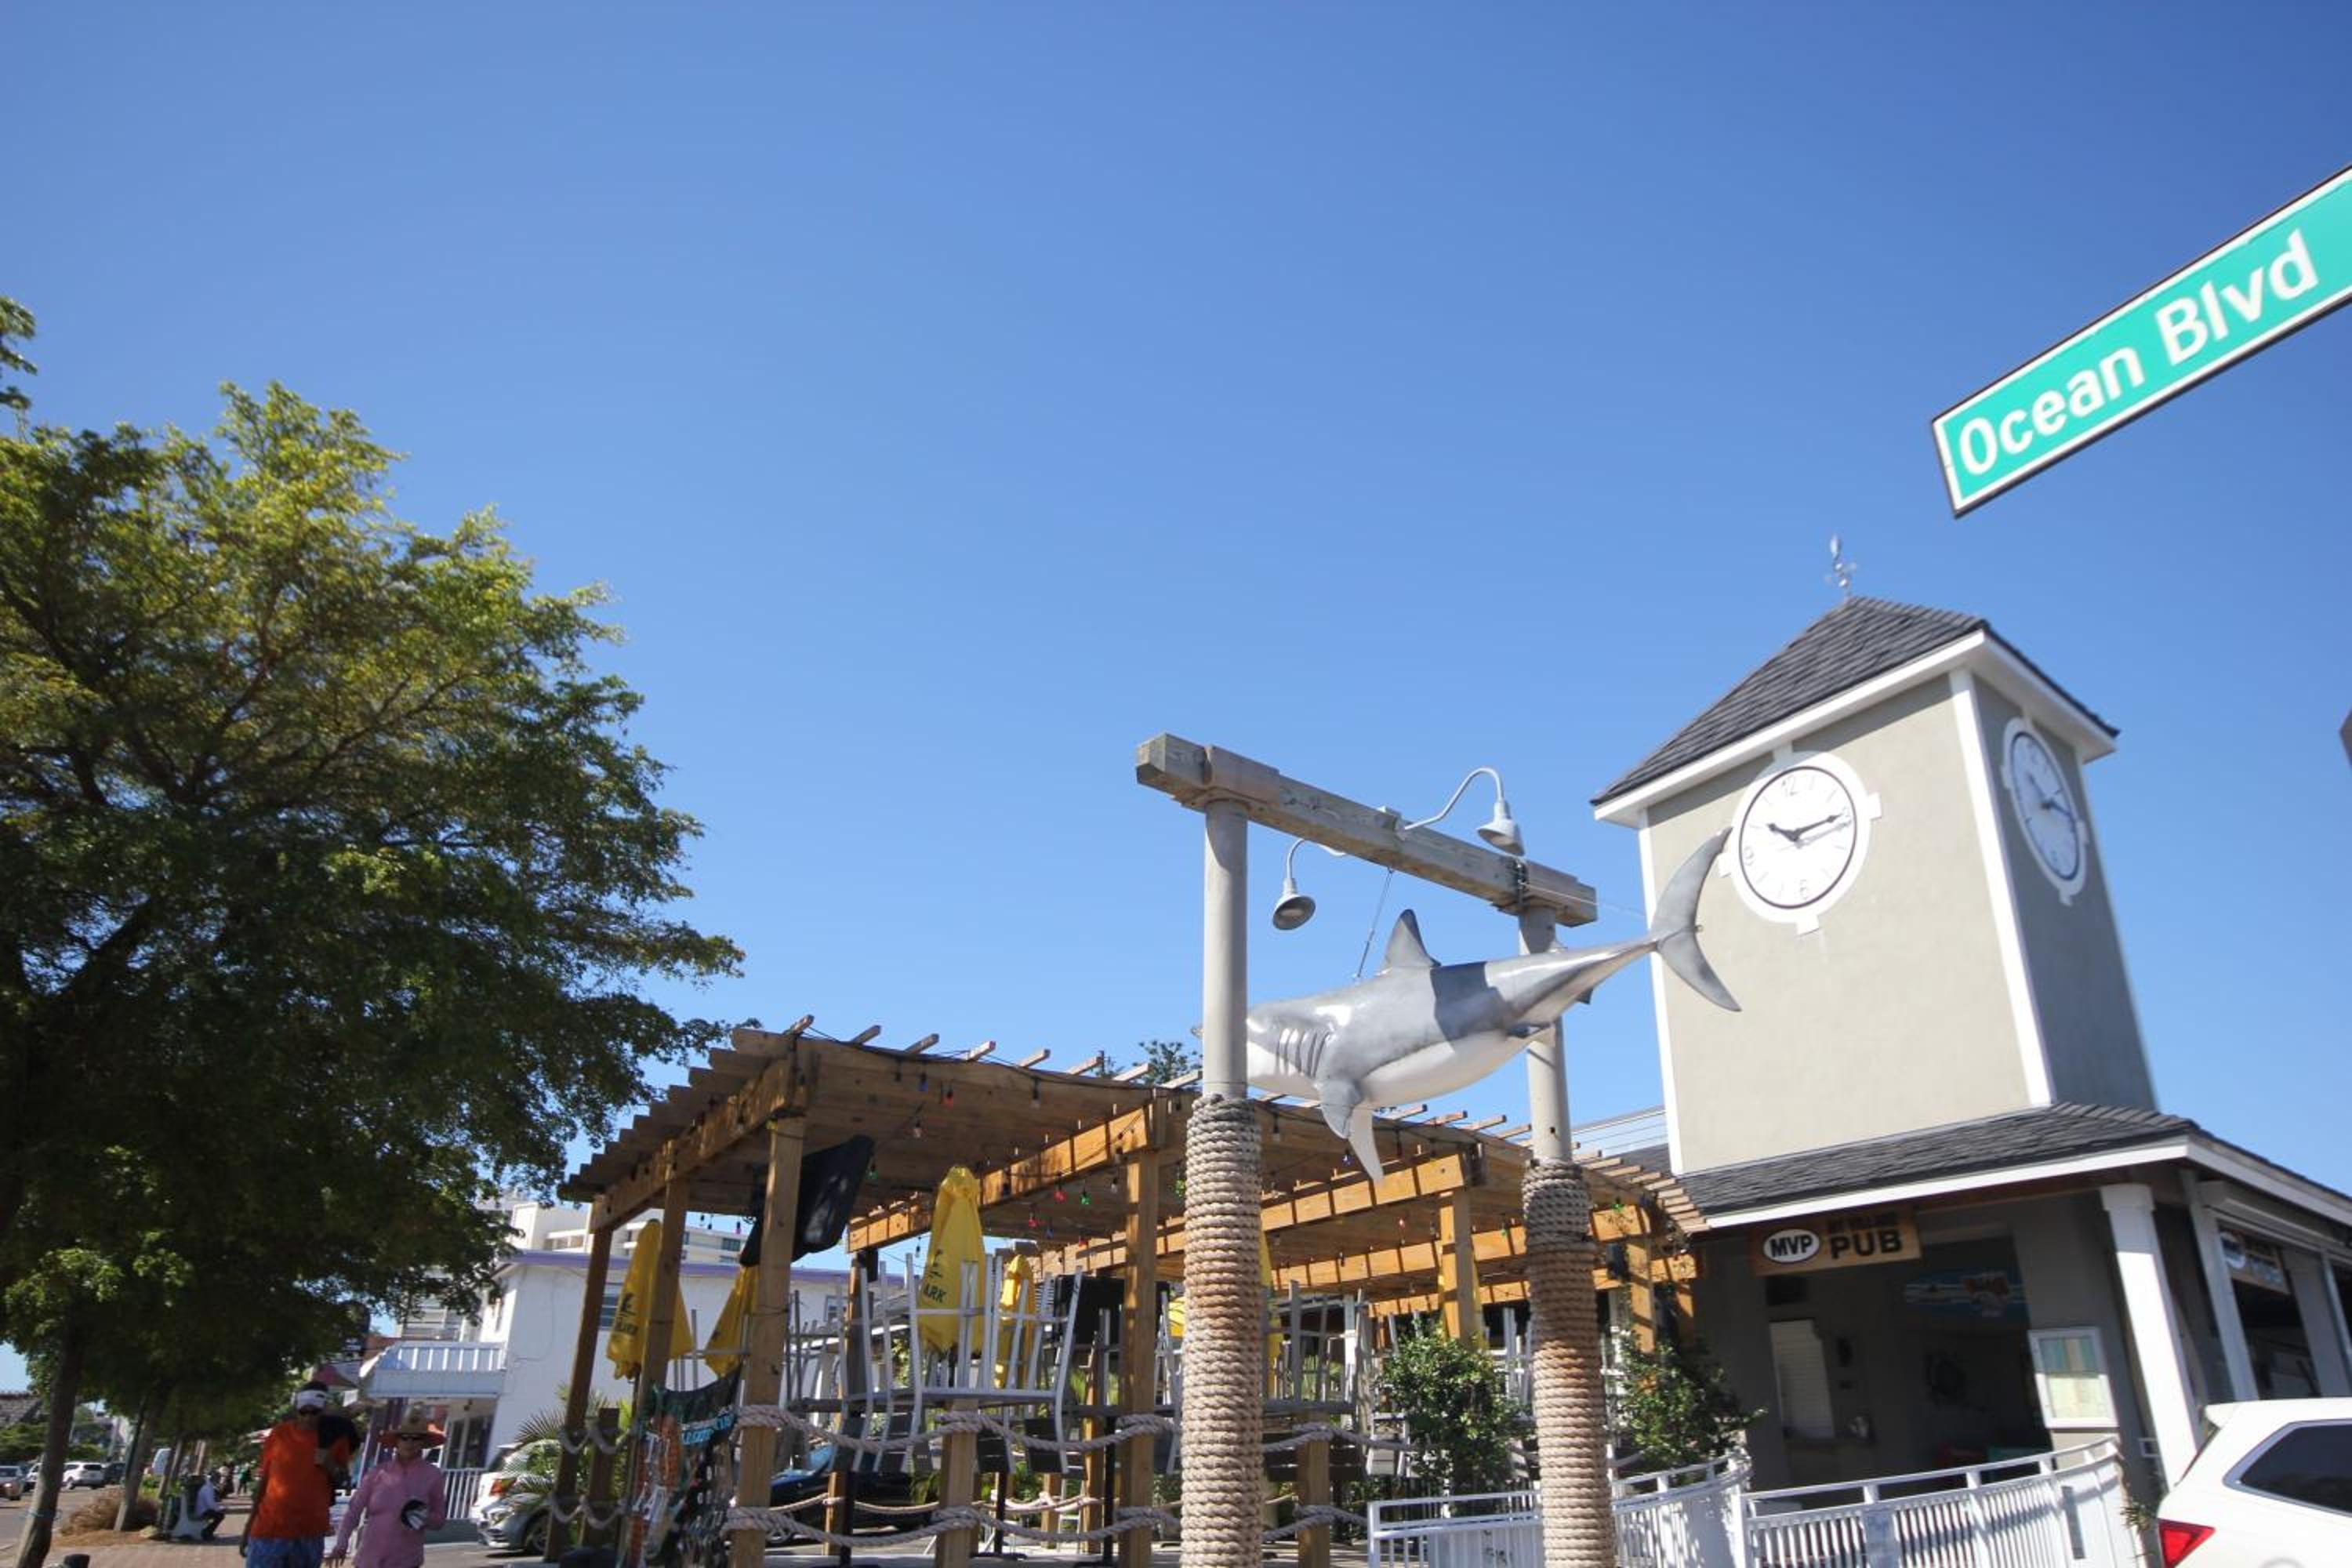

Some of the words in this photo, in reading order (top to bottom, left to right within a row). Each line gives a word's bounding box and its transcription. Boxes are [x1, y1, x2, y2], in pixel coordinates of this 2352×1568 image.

[1960, 346, 2145, 476] Ocean
[2154, 229, 2318, 367] Blvd
[1769, 1234, 1813, 1258] MVP
[1831, 1229, 1902, 1259] PUB
